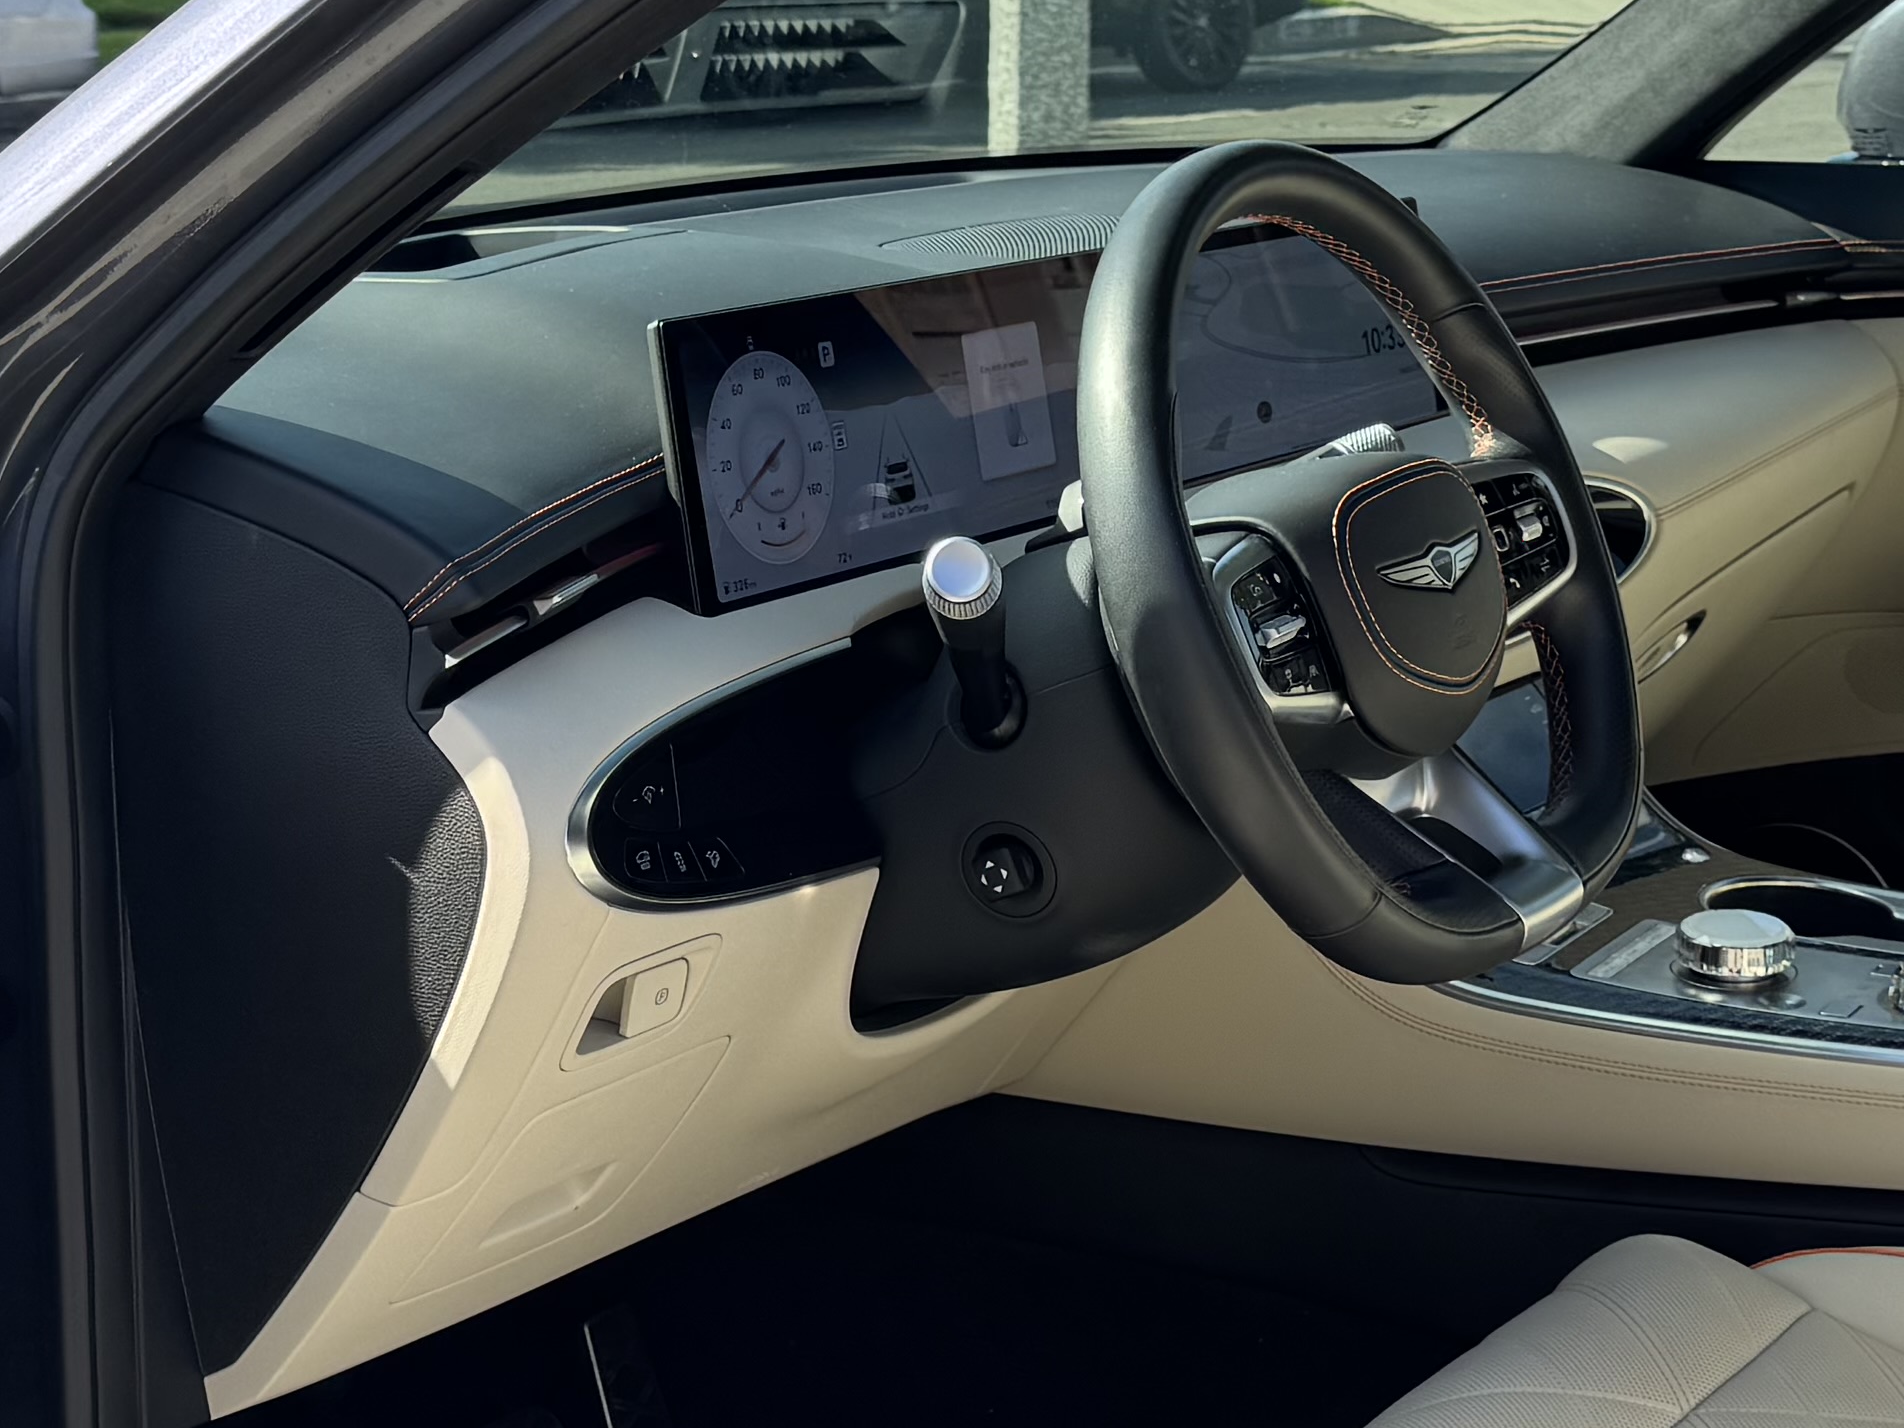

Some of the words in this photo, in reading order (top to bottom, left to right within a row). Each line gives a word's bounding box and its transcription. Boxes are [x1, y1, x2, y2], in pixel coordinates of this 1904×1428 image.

[822, 345, 830, 363] P
[753, 368, 765, 380] 80
[776, 374, 791, 388] 100
[731, 383, 743, 396] 60
[796, 402, 811, 415] 120
[720, 418, 732, 430] 40
[807, 440, 823, 453] 140
[720, 459, 732, 473] 20
[807, 482, 822, 496] 160
[735, 498, 744, 512] 0
